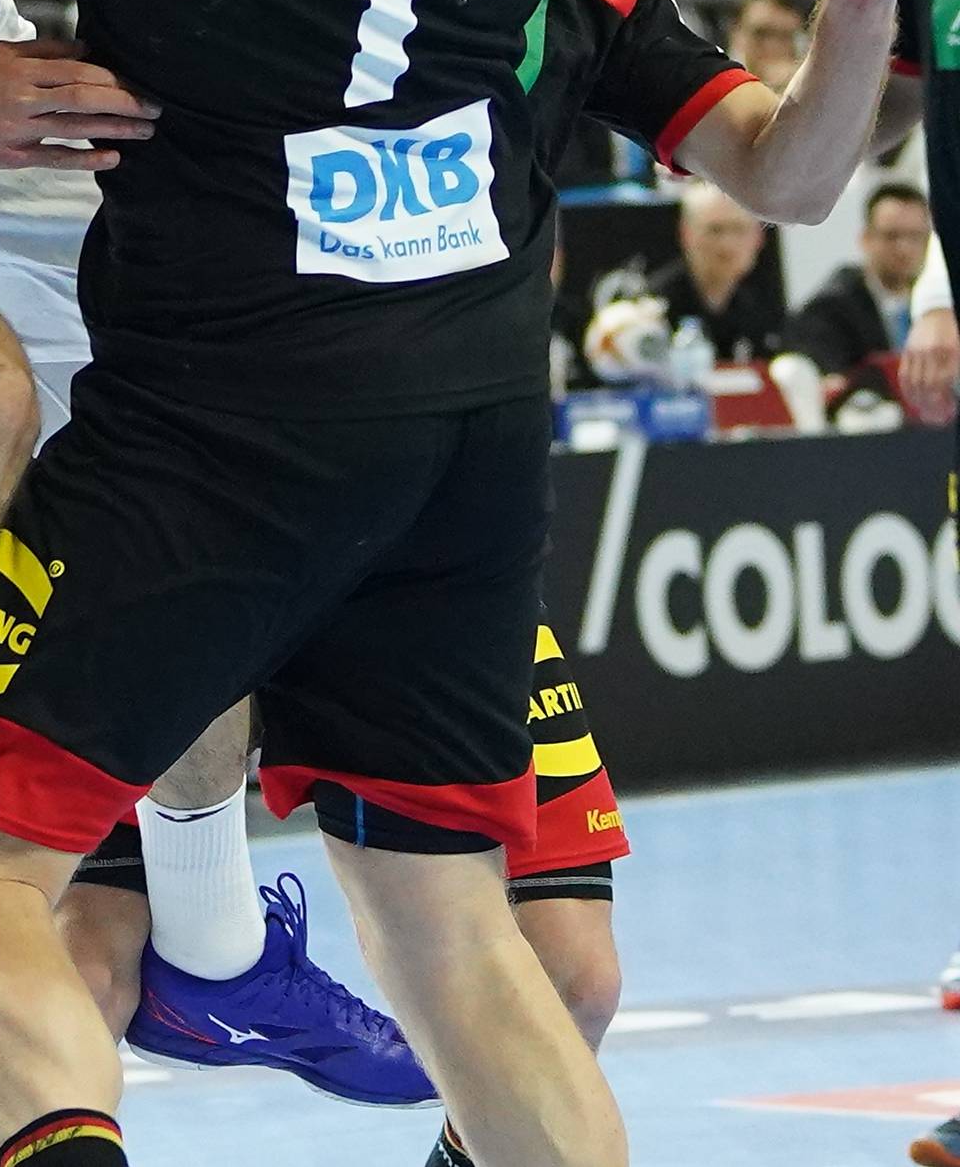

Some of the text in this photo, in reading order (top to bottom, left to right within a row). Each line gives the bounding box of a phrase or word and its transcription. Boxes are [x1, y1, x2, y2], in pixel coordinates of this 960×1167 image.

[309, 132, 481, 224] DKB
[320, 219, 483, 260] Das kann Bank
